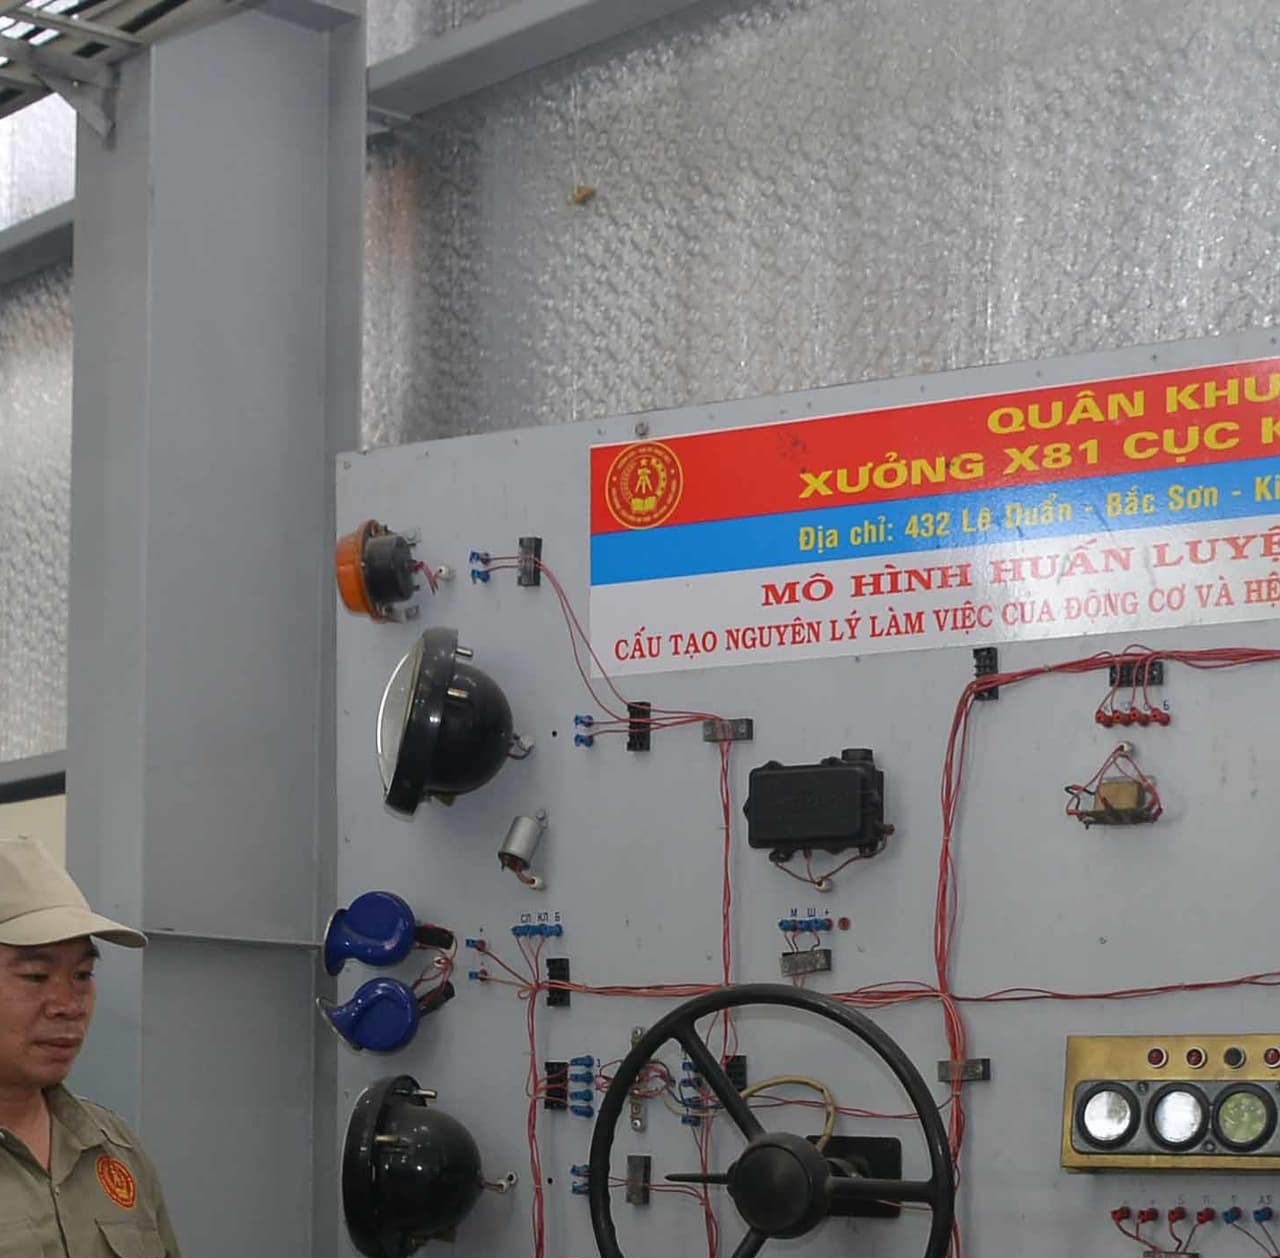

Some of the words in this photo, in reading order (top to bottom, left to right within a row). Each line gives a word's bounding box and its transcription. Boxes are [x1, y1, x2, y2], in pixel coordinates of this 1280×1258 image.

[987, 390, 1145, 434] QUÂN
[798, 451, 983, 498] XƯỞNG
[1003, 439, 1099, 475] X81
[1122, 421, 1240, 461] CỤC
[798, 525, 839, 553] Địa
[850, 516, 894, 546] chỉ:
[905, 512, 950, 539] 432
[962, 506, 992, 533] Lê
[1005, 492, 1072, 528] Duẩn
[1106, 486, 1156, 517] Bắc
[1168, 483, 1218, 511] Sơn
[761, 573, 833, 606] MÔ
[849, 563, 973, 597] HÌNH
[990, 540, 1137, 584] HUẤN
[615, 627, 661, 660] CẤU
[669, 631, 718, 658] TẠO
[725, 616, 823, 651] NGUYÊN
[830, 610, 861, 642] LÝ
[870, 607, 926, 637] LÀM
[933, 601, 995, 634] VIỆC
[1002, 590, 1057, 624] CỦA
[1064, 590, 1140, 623] ĐỘNG
[1147, 583, 1188, 612] CƠ
[1195, 575, 1235, 608] VÀ
